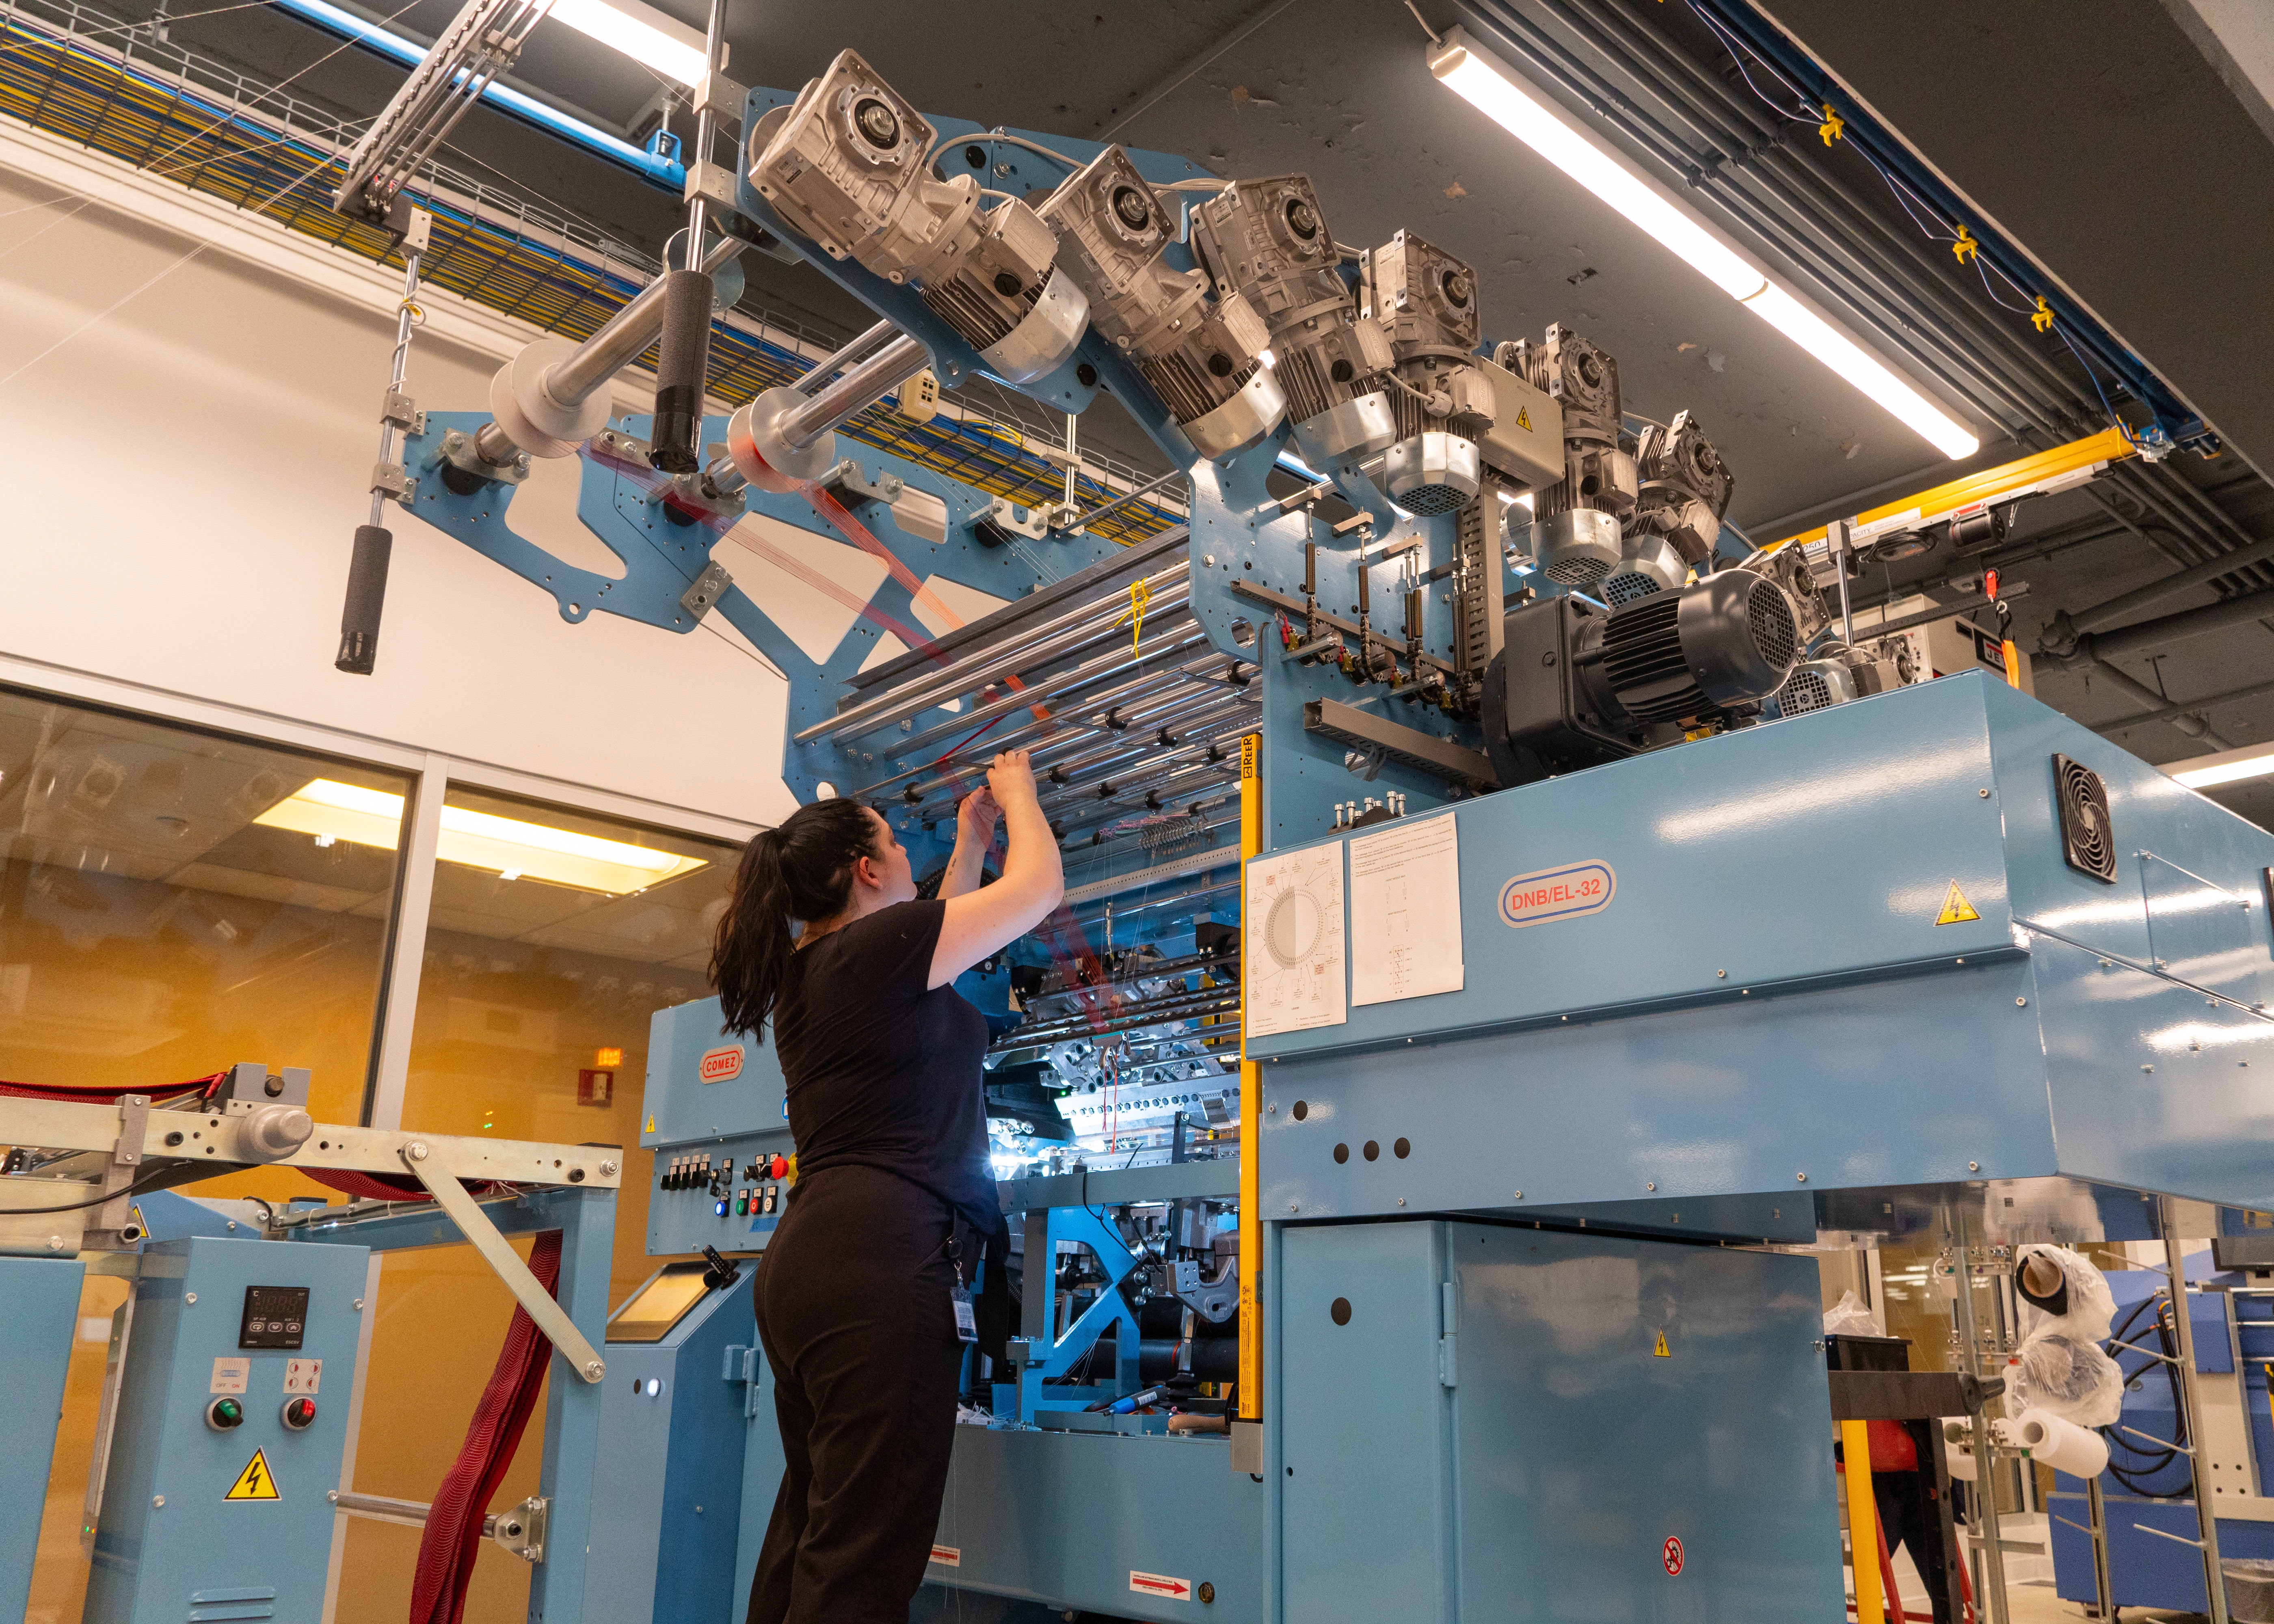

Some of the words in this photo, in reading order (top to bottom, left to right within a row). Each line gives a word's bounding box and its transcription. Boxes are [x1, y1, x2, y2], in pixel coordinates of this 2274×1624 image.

[1987, 650, 2003, 663] JE
[1243, 737, 1252, 765] REER
[1512, 879, 1600, 910] DNB/EL-32
[706, 1056, 736, 1072] COMEZ
